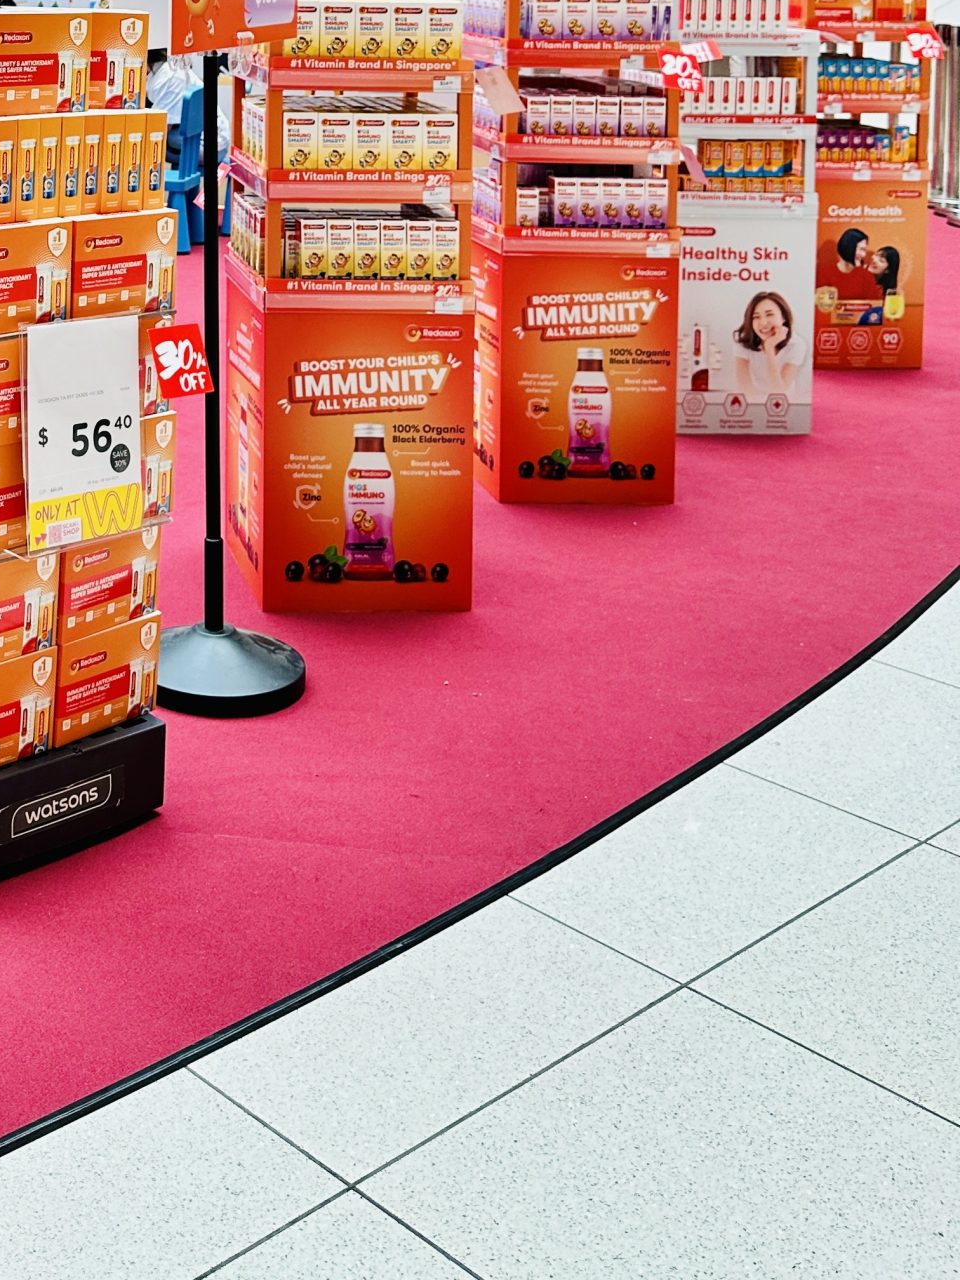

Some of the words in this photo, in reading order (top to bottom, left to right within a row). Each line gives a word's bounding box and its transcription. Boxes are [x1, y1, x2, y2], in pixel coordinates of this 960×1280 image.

[524, 41, 534, 49] #1
[536, 41, 571, 49] Vitamin
[573, 42, 600, 50] Brand
[290, 60, 302, 69] #1
[304, 60, 345, 69] Vitamin
[348, 60, 380, 70] Brand
[384, 60, 394, 70] In
[661, 54, 702, 79] 20%
[677, 78, 700, 91] OFF
[828, 204, 862, 217] Good
[864, 205, 902, 216] health
[682, 246, 748, 264] Healthy
[753, 247, 789, 261] Skin
[682, 268, 770, 281] Inside-Out
[532, 295, 570, 305] BOOST
[572, 294, 604, 304] YOUR
[605, 291, 650, 301] CHILD'S
[527, 302, 656, 326] IMMUNITY
[422, 329, 460, 337] Redoxon
[546, 326, 566, 337] ALL
[568, 326, 597, 336] YEAR
[599, 324, 639, 334] ROUND
[155, 338, 206, 380] 30%
[300, 360, 346, 372] BOOST
[349, 357, 384, 370] YOUR
[387, 354, 440, 367] CHILD'S
[179, 372, 206, 392] OFF
[294, 367, 447, 397] IMMUNITY
[317, 399, 340, 411] ALL
[343, 397, 378, 409] YEAR
[380, 394, 427, 407] ROUND
[114, 415, 132, 429] 40
[392, 424, 420, 433] 100%
[423, 424, 465, 435] Organic
[38, 427, 48, 447] $
[72, 419, 112, 457] 56
[392, 436, 416, 444] Black
[419, 436, 466, 445] Elderberry
[112, 450, 128, 459] SAVE
[114, 460, 127, 468] 30%
[303, 493, 322, 502] Zinc
[65, 498, 80, 515] AT
[63, 526, 80, 536] SHOP
[25, 785, 98, 823] watsons
